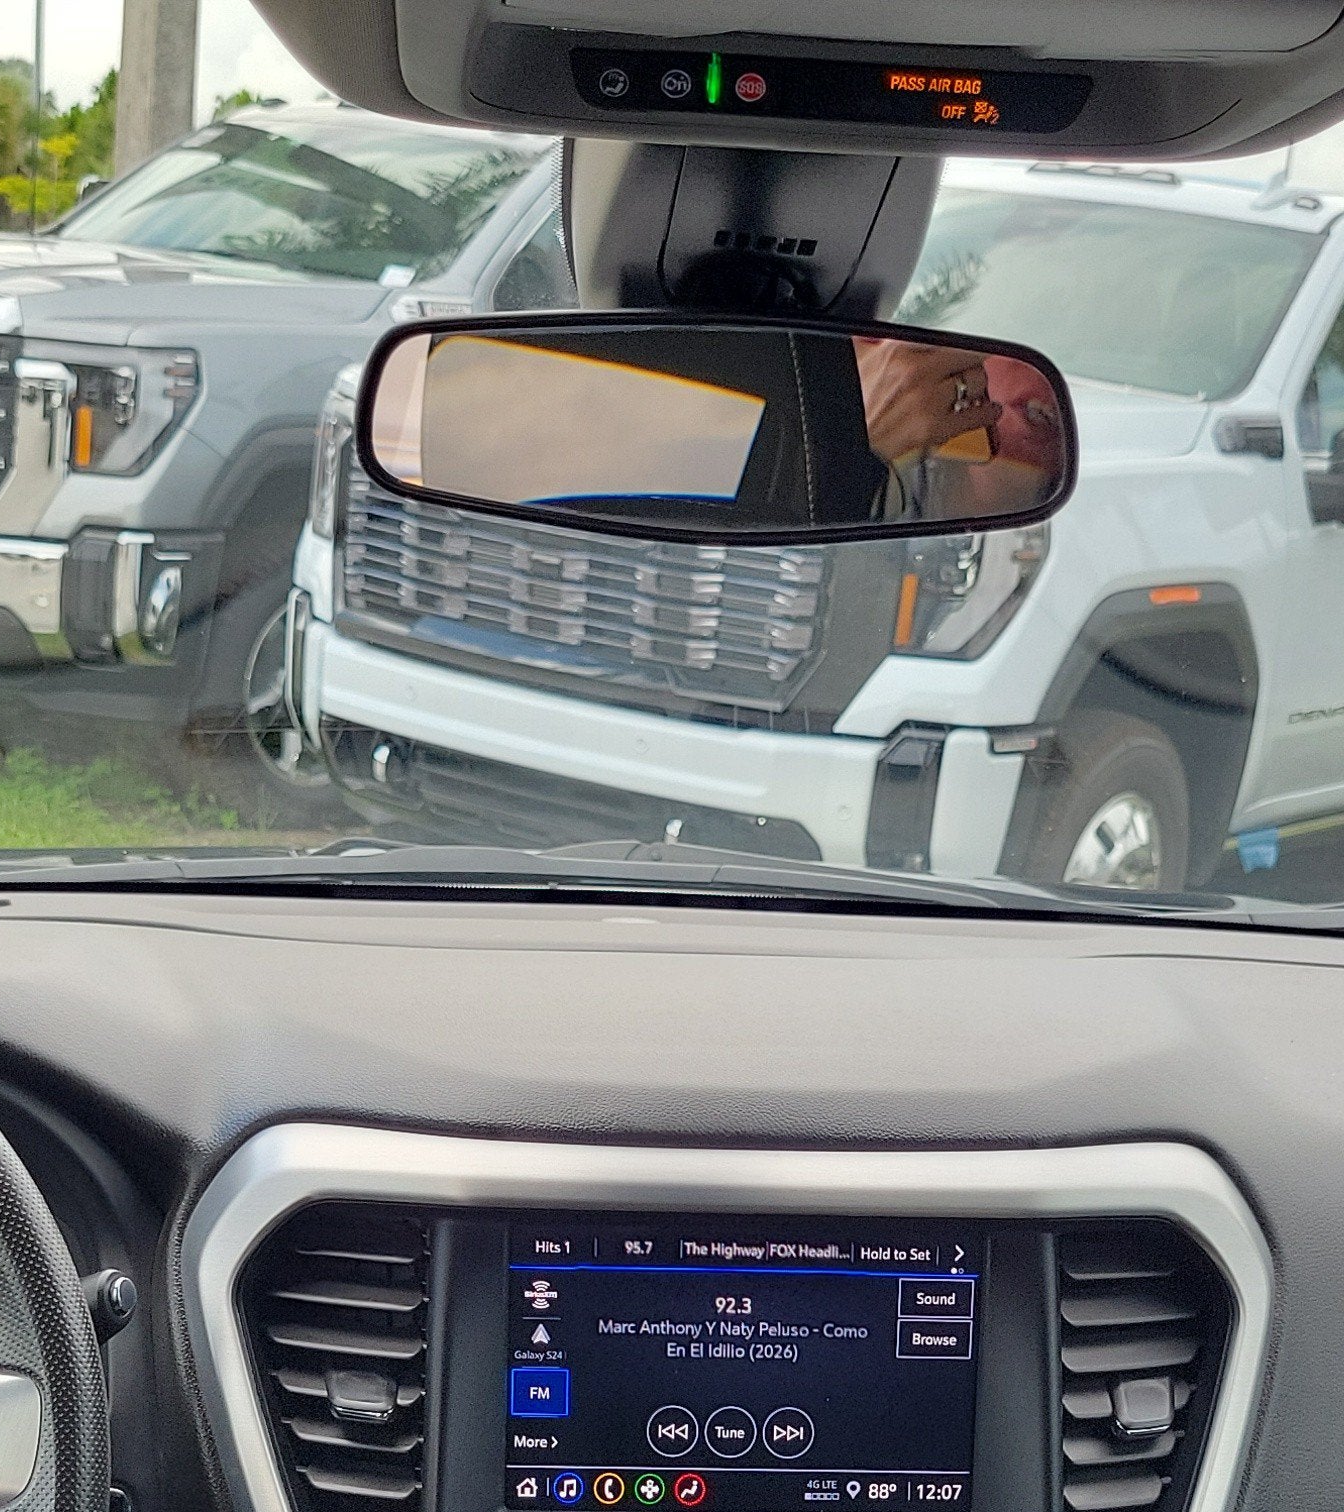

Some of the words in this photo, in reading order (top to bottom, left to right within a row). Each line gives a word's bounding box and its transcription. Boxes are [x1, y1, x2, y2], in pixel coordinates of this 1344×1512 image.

[890, 76, 926, 91] PASS
[928, 79, 951, 93] AIR
[953, 79, 982, 95] BAG
[941, 105, 967, 119] OFF
[535, 1240, 561, 1254] Hits
[565, 1240, 570, 1254] 1
[624, 1240, 653, 1255] 95.7
[684, 1242, 708, 1255] The
[711, 1243, 765, 1260] Highway
[770, 1244, 796, 1258] FOX
[860, 1247, 891, 1261] Hold
[893, 1249, 907, 1261] to
[909, 1248, 931, 1261] Set
[715, 1297, 752, 1314] 92.3
[916, 1292, 956, 1306] Sound
[598, 1319, 636, 1335] Marc
[639, 1320, 702, 1339] Anthony
[705, 1321, 716, 1335] Y
[720, 1322, 755, 1340] Naty
[759, 1322, 810, 1338] Peluso
[823, 1323, 868, 1339] Como
[912, 1333, 957, 1346] Browse
[514, 1350, 545, 1362] Galaxy
[546, 1351, 563, 1360] S24
[667, 1343, 685, 1357] En
[690, 1343, 703, 1358] El
[708, 1343, 745, 1359] Idilio
[749, 1344, 798, 1362] (2026)
[529, 1387, 550, 1400] FM
[715, 1426, 746, 1439] Tune
[514, 1435, 548, 1448] More
[807, 1480, 820, 1490] 4G
[822, 1480, 838, 1490] LTE
[916, 1484, 963, 1500] 12:07
